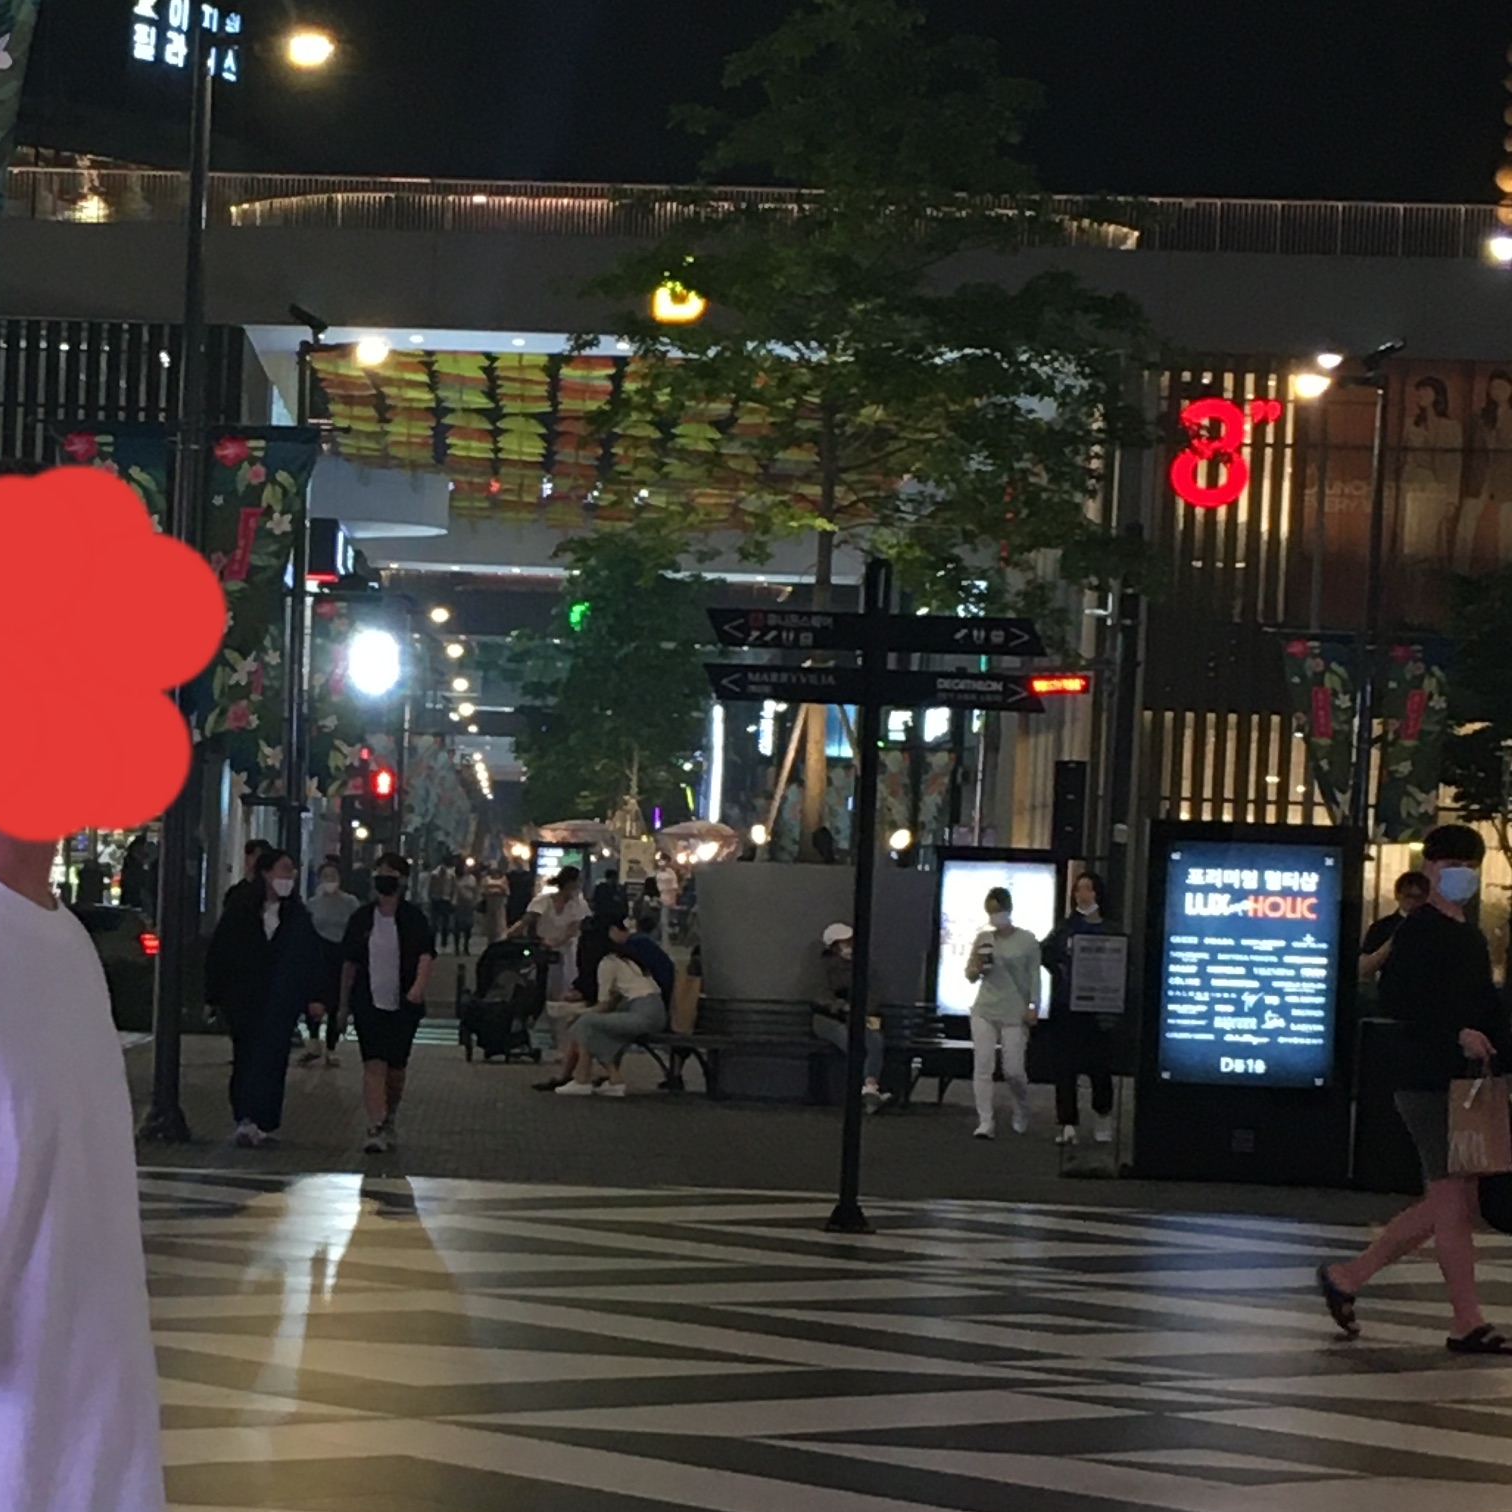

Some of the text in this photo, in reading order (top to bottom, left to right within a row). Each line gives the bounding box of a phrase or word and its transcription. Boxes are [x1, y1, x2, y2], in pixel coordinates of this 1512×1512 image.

[935, 677, 1004, 692] DECATHLON
[1185, 868, 1320, 892] 프리미엄 멀티샵
